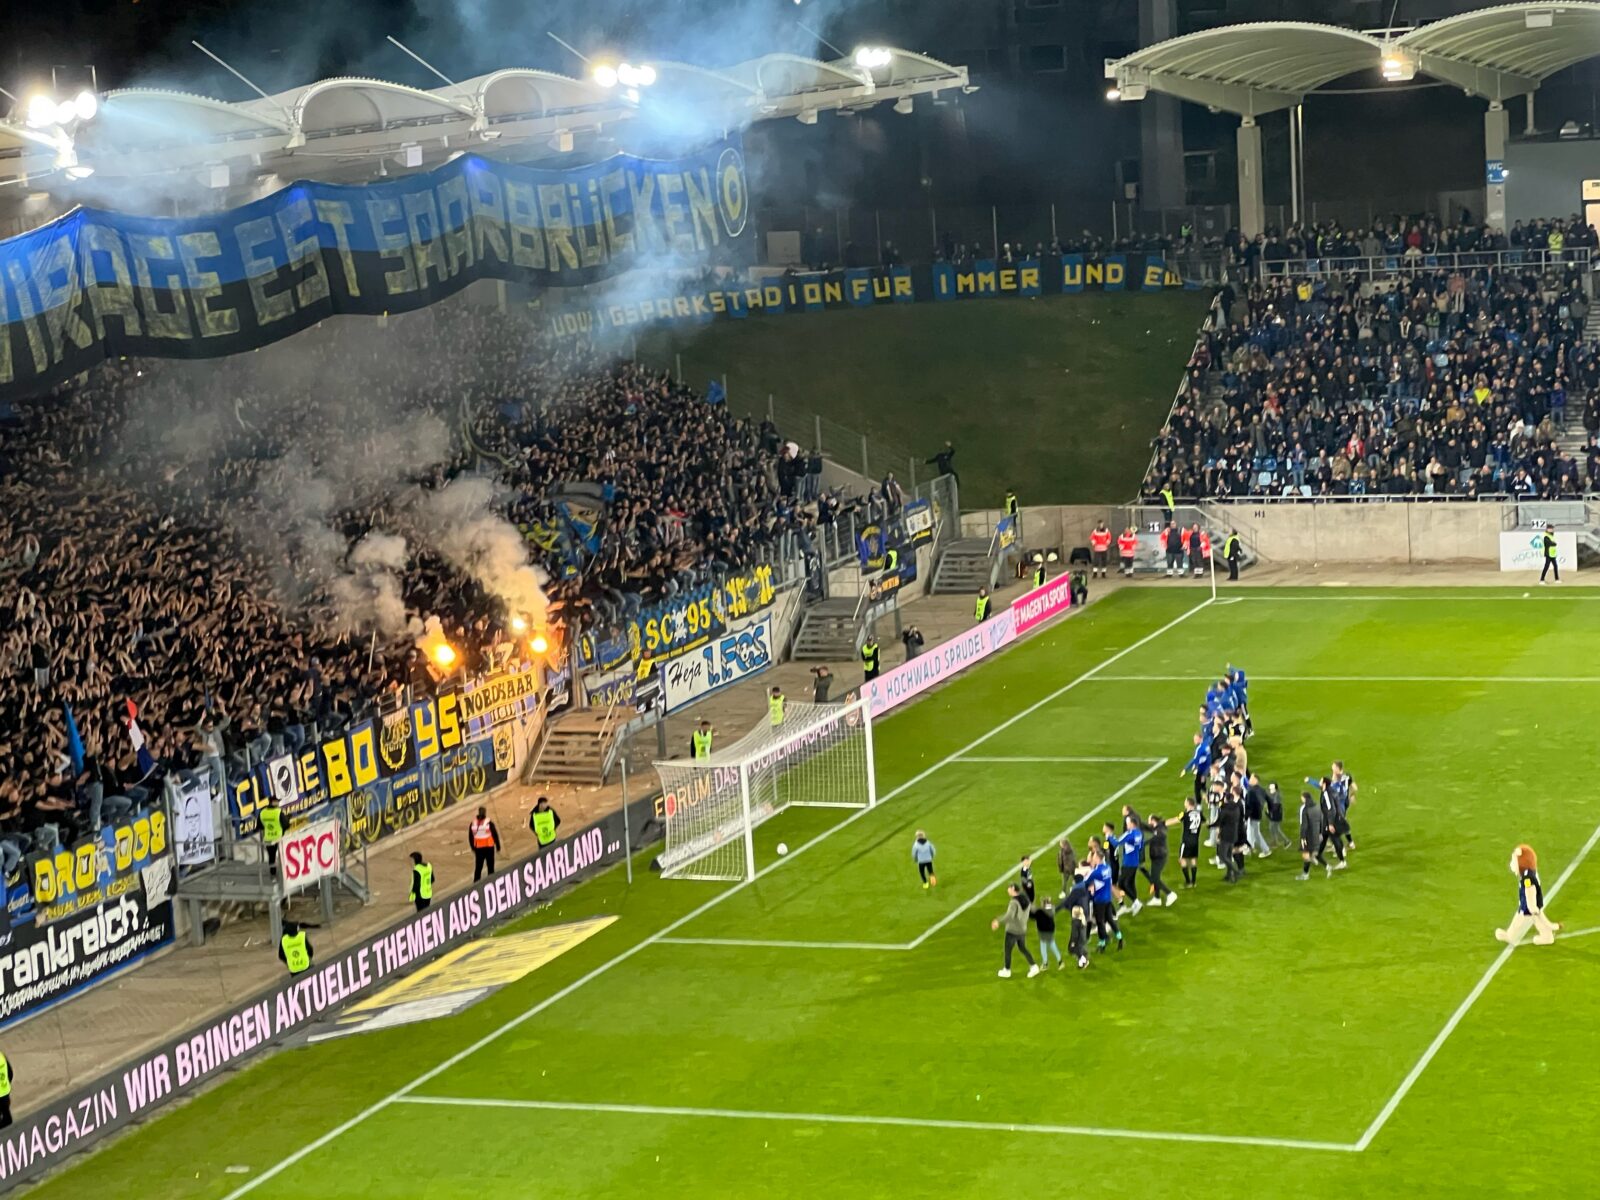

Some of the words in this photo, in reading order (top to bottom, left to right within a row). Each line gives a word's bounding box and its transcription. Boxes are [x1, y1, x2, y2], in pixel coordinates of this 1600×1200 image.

[1487, 162, 1503, 171] WC
[234, 194, 361, 326] EST
[365, 166, 719, 295] SAARBRÜCKEN
[551, 281, 842, 337] UDWIGSPARKSTADION
[940, 267, 1040, 295] IMMER
[1064, 263, 1123, 286] UND
[668, 660, 702, 692] Heja
[886, 656, 942, 702] HOCHWALD
[944, 631, 986, 671] SPRUDEL
[655, 774, 712, 819] FORUM
[713, 765, 739, 794] DAS
[284, 831, 336, 881] SFC
[123, 1053, 172, 1114] WIR
[175, 1000, 271, 1087] BRINGEN
[275, 946, 372, 1034] AKTUELLE
[372, 907, 446, 973] THEMEN
[449, 889, 482, 939] AUS
[483, 873, 522, 917] DEM
[523, 826, 604, 898] SAARLAND
